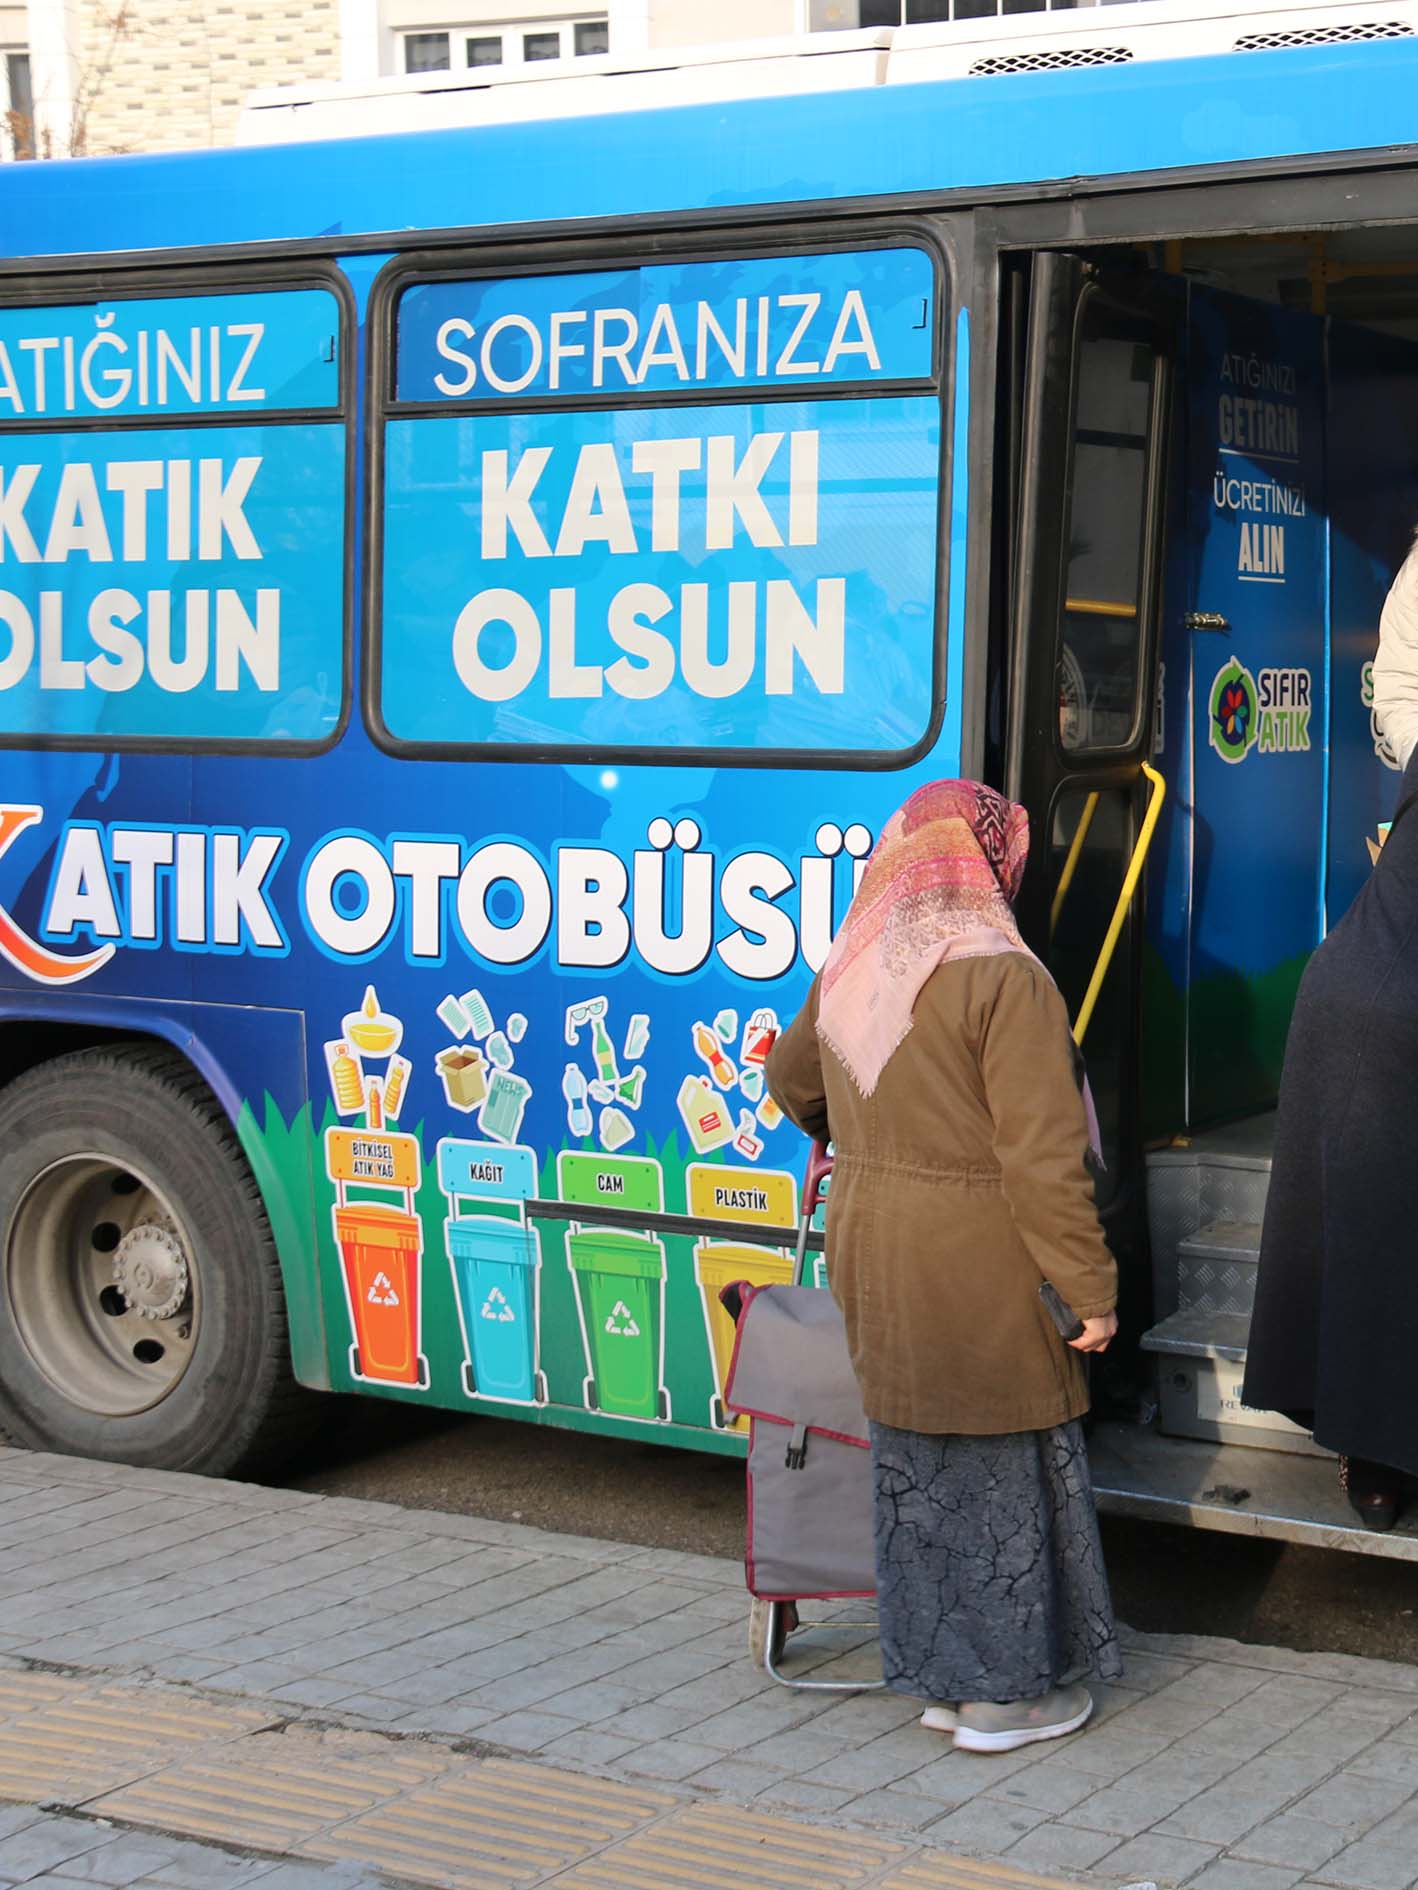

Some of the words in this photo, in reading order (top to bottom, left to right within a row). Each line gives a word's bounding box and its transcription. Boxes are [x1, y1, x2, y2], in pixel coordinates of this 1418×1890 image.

[433, 289, 881, 396] SOFRANIZA
[480, 429, 820, 560] KATKI
[1213, 471, 1305, 517] ÜCRETİNİZİ
[1238, 522, 1285, 574] ALIN
[452, 577, 846, 702] OLSUN
[1260, 673, 1309, 707] SIFIR
[1260, 711, 1309, 748] ATIK
[352, 1138, 393, 1159] BİTKİSEL
[353, 1161, 374, 1175] ATIK
[377, 1160, 394, 1178] YAĞ
[470, 1162, 503, 1183] KAĞIT
[597, 1175, 624, 1192] CAM
[715, 1187, 768, 1210] PLASTİK
